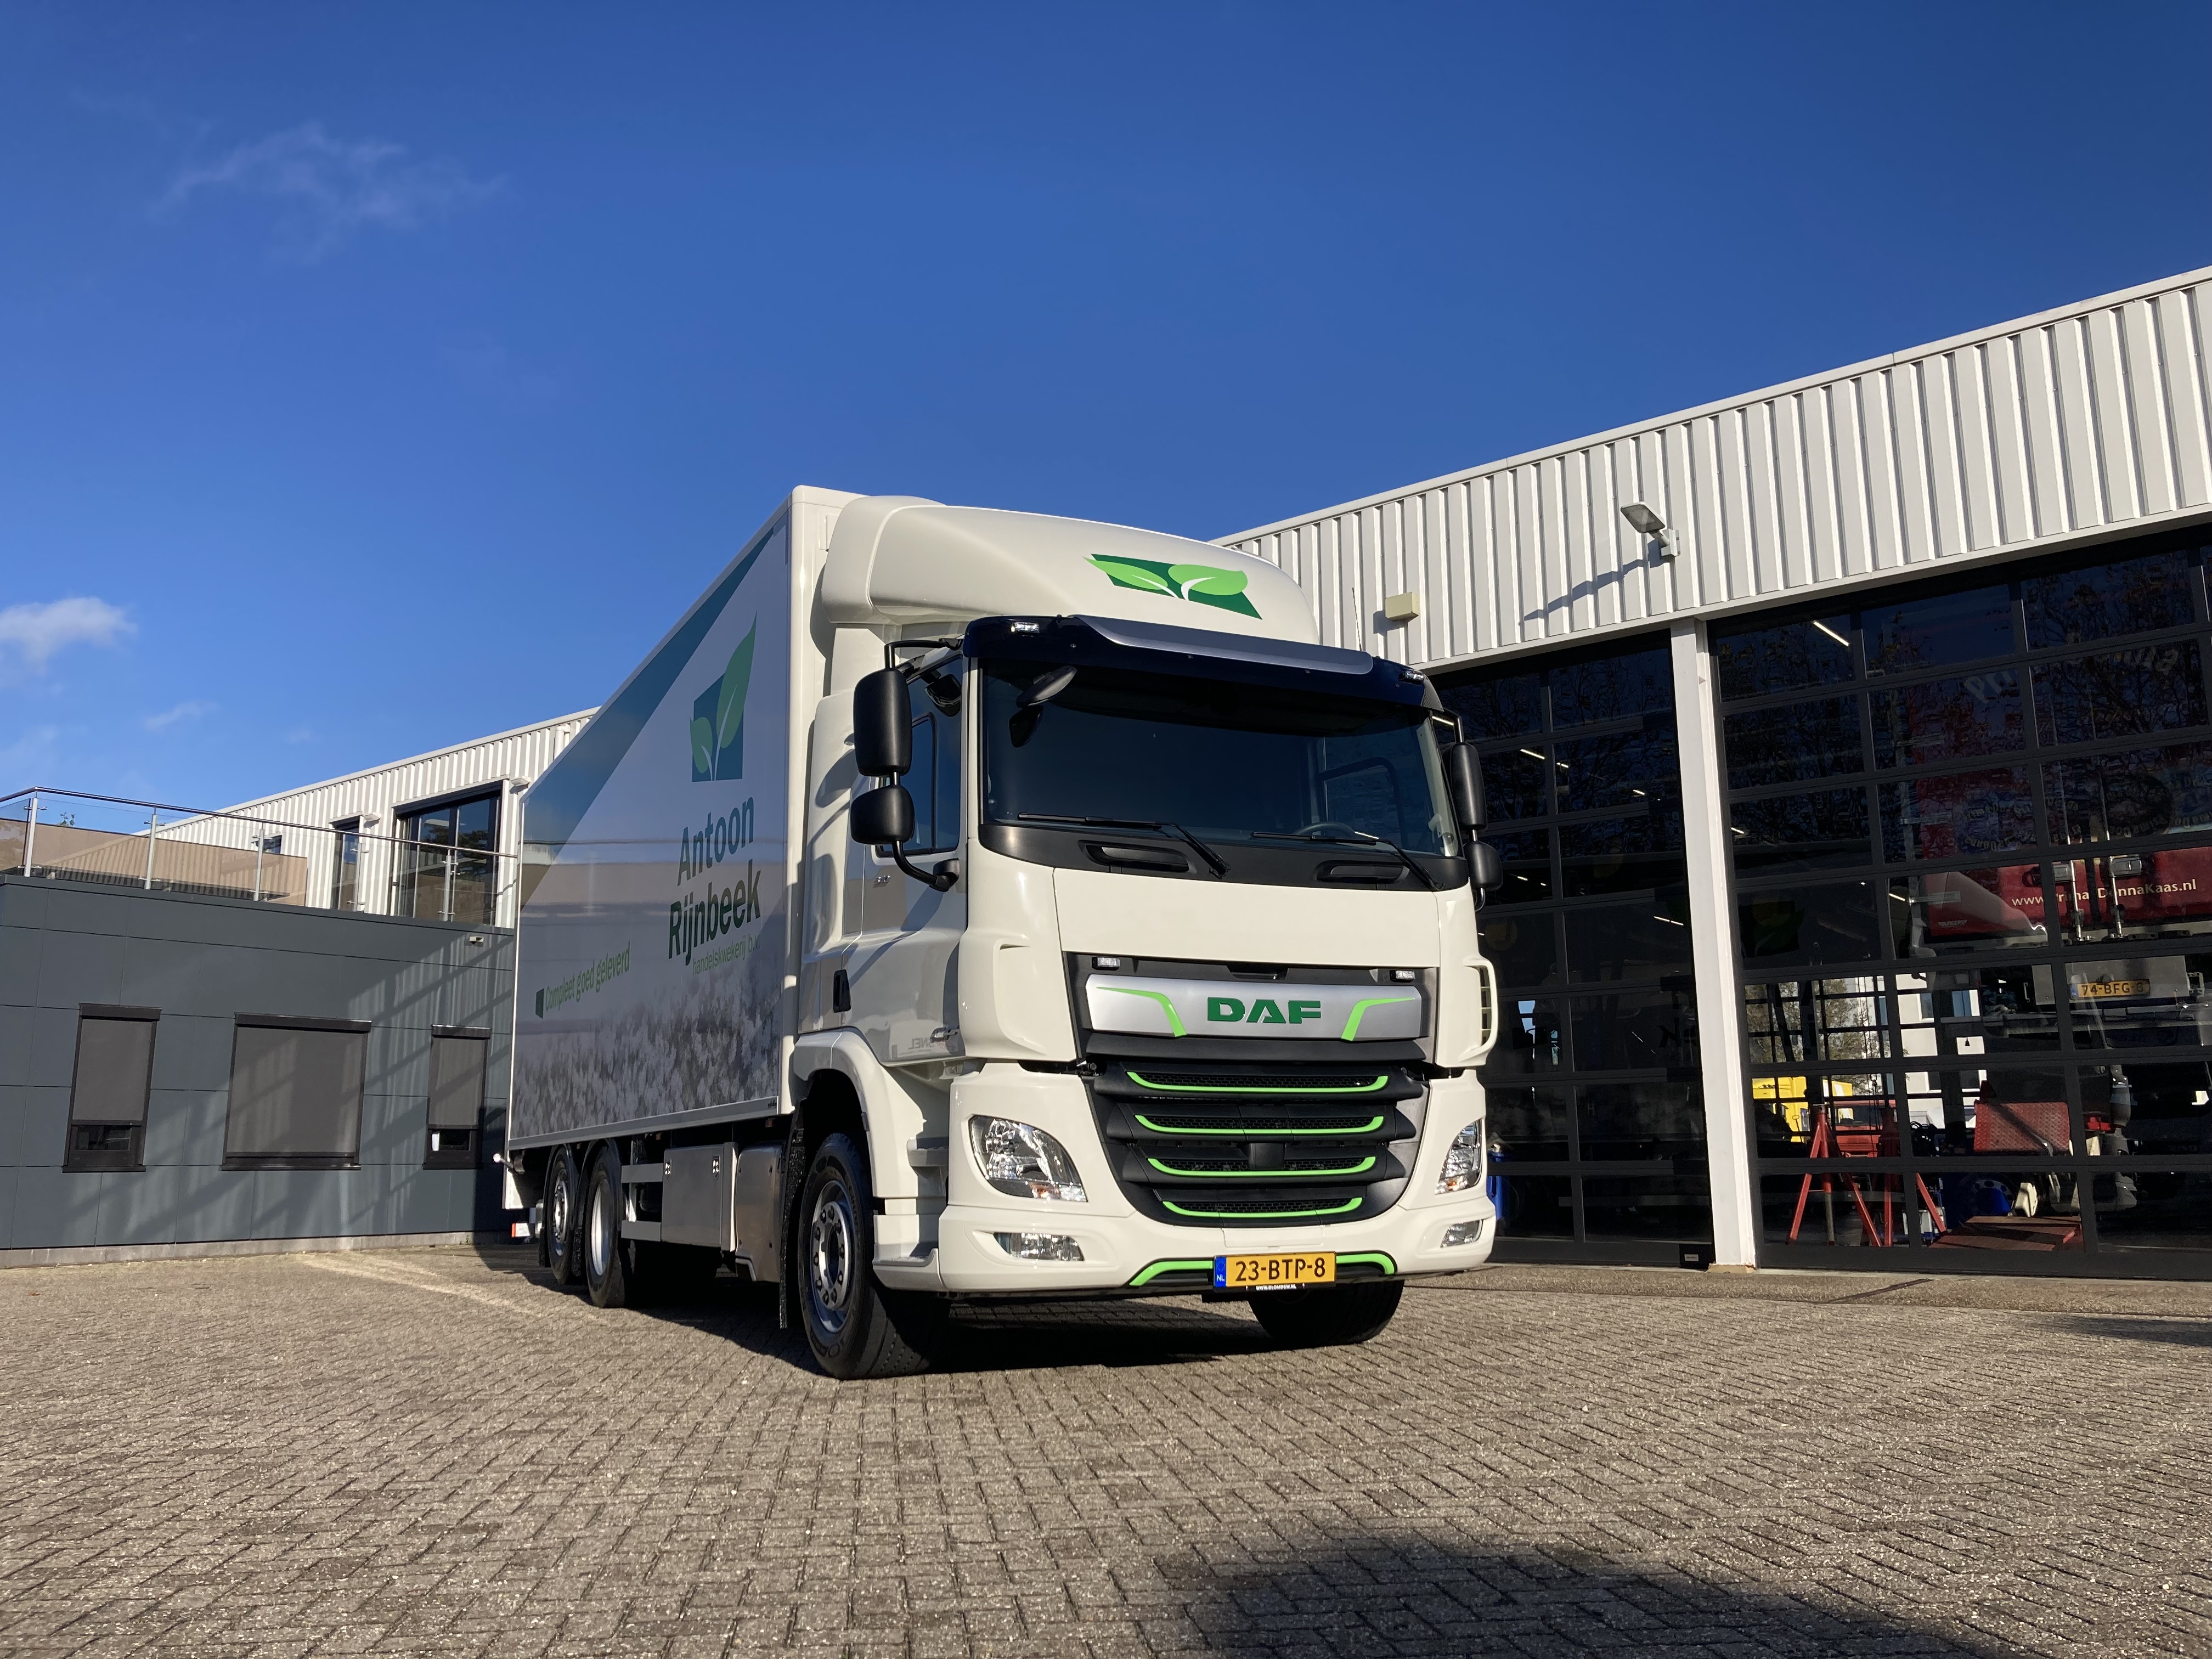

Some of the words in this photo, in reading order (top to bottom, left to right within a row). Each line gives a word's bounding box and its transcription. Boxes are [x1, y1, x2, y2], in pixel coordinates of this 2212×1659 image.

[678, 797, 754, 886] Antoon
[669, 859, 761, 966] Rijnbeek
[545, 973, 575, 1012] Compleet
[576, 959, 595, 1002] goed
[596, 940, 630, 993] geleverd
[692, 935, 746, 975] handelskwekerij
[748, 934, 760, 953] b.v.
[1207, 997, 1322, 1024] DAF
[1216, 1274, 1225, 1282] NL
[1235, 1257, 1325, 1282] 23-BTP-8
